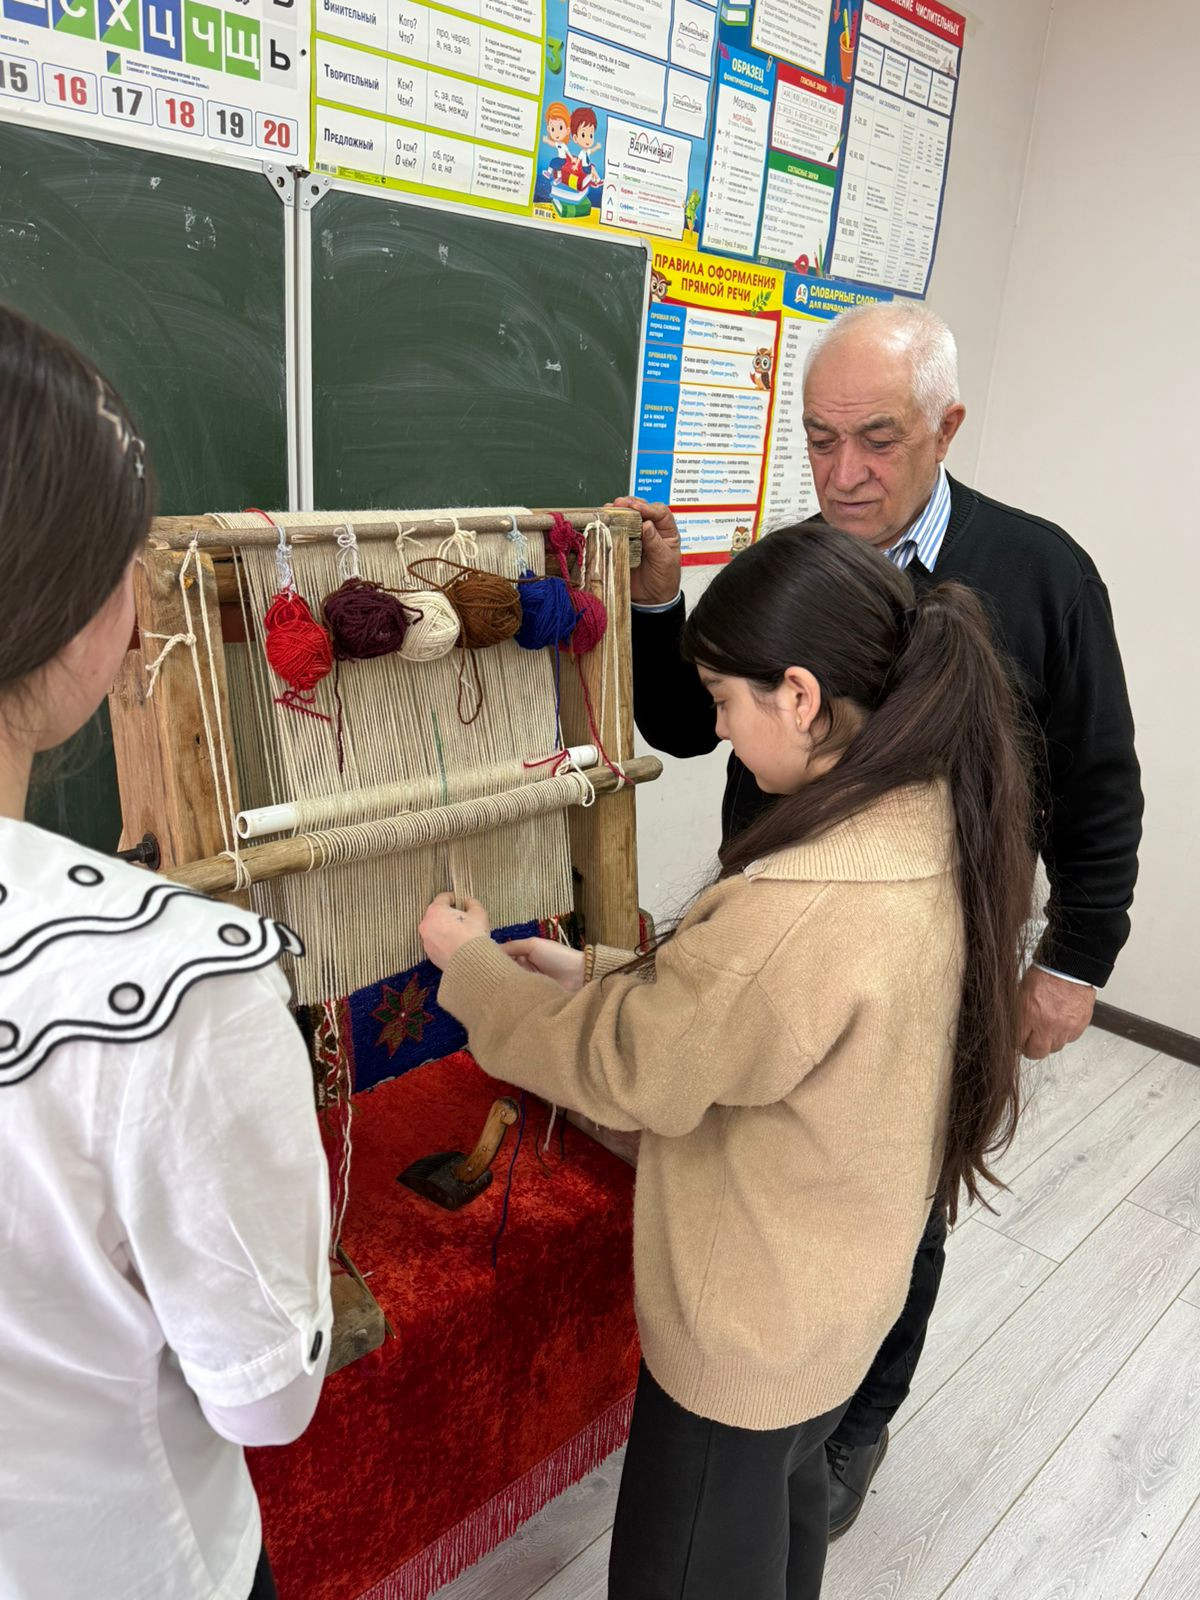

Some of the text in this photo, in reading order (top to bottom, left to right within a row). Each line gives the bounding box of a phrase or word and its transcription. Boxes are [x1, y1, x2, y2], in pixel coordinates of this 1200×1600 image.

[915, 1, 960, 37] ЧИСЛИТЕЛЬНЫХ
[149, 5, 175, 49] Ц
[192, 17, 214, 53] Ч
[226, 26, 260, 70] Щ
[732, 58, 764, 83] ОБРАЗЕЦ
[54, 73, 88, 105] 16
[111, 86, 143, 116] 17
[165, 98, 195, 129] 18
[216, 109, 244, 139] 19
[263, 119, 291, 148] 20
[654, 253, 776, 290] ПРАВИЛА ОФОРМЛЕНИЯ
[681, 277, 751, 302] ПРЯМОЙ РЕЧИ
[810, 285, 855, 304] СЛОВАРНЫЕ
